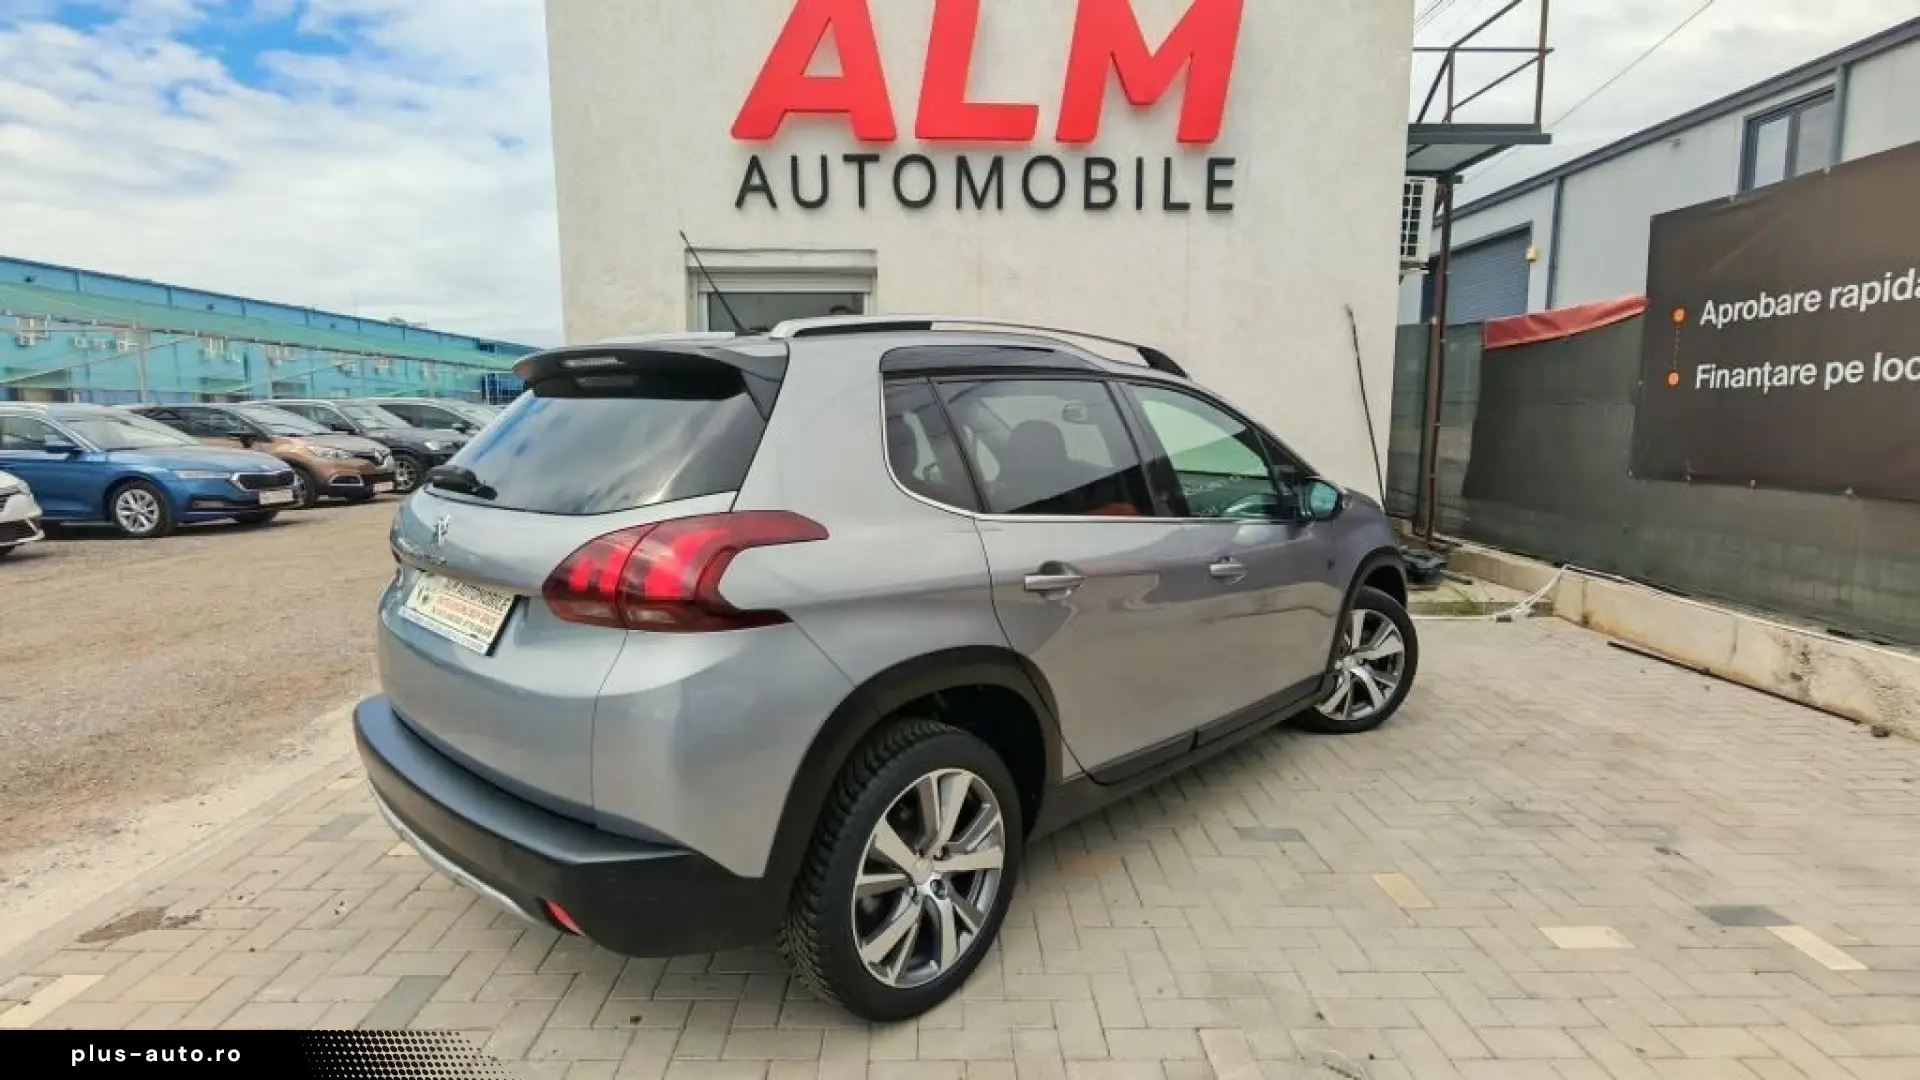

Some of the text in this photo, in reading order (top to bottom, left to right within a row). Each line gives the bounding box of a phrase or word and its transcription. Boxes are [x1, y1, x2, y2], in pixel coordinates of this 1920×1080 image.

[731, 0, 1243, 143] ALM
[735, 154, 1236, 212] AUTOMOBILE
[1699, 289, 1822, 329] Aprobare
[1694, 361, 1818, 395] Finanțare
[1823, 359, 1865, 391] pe
